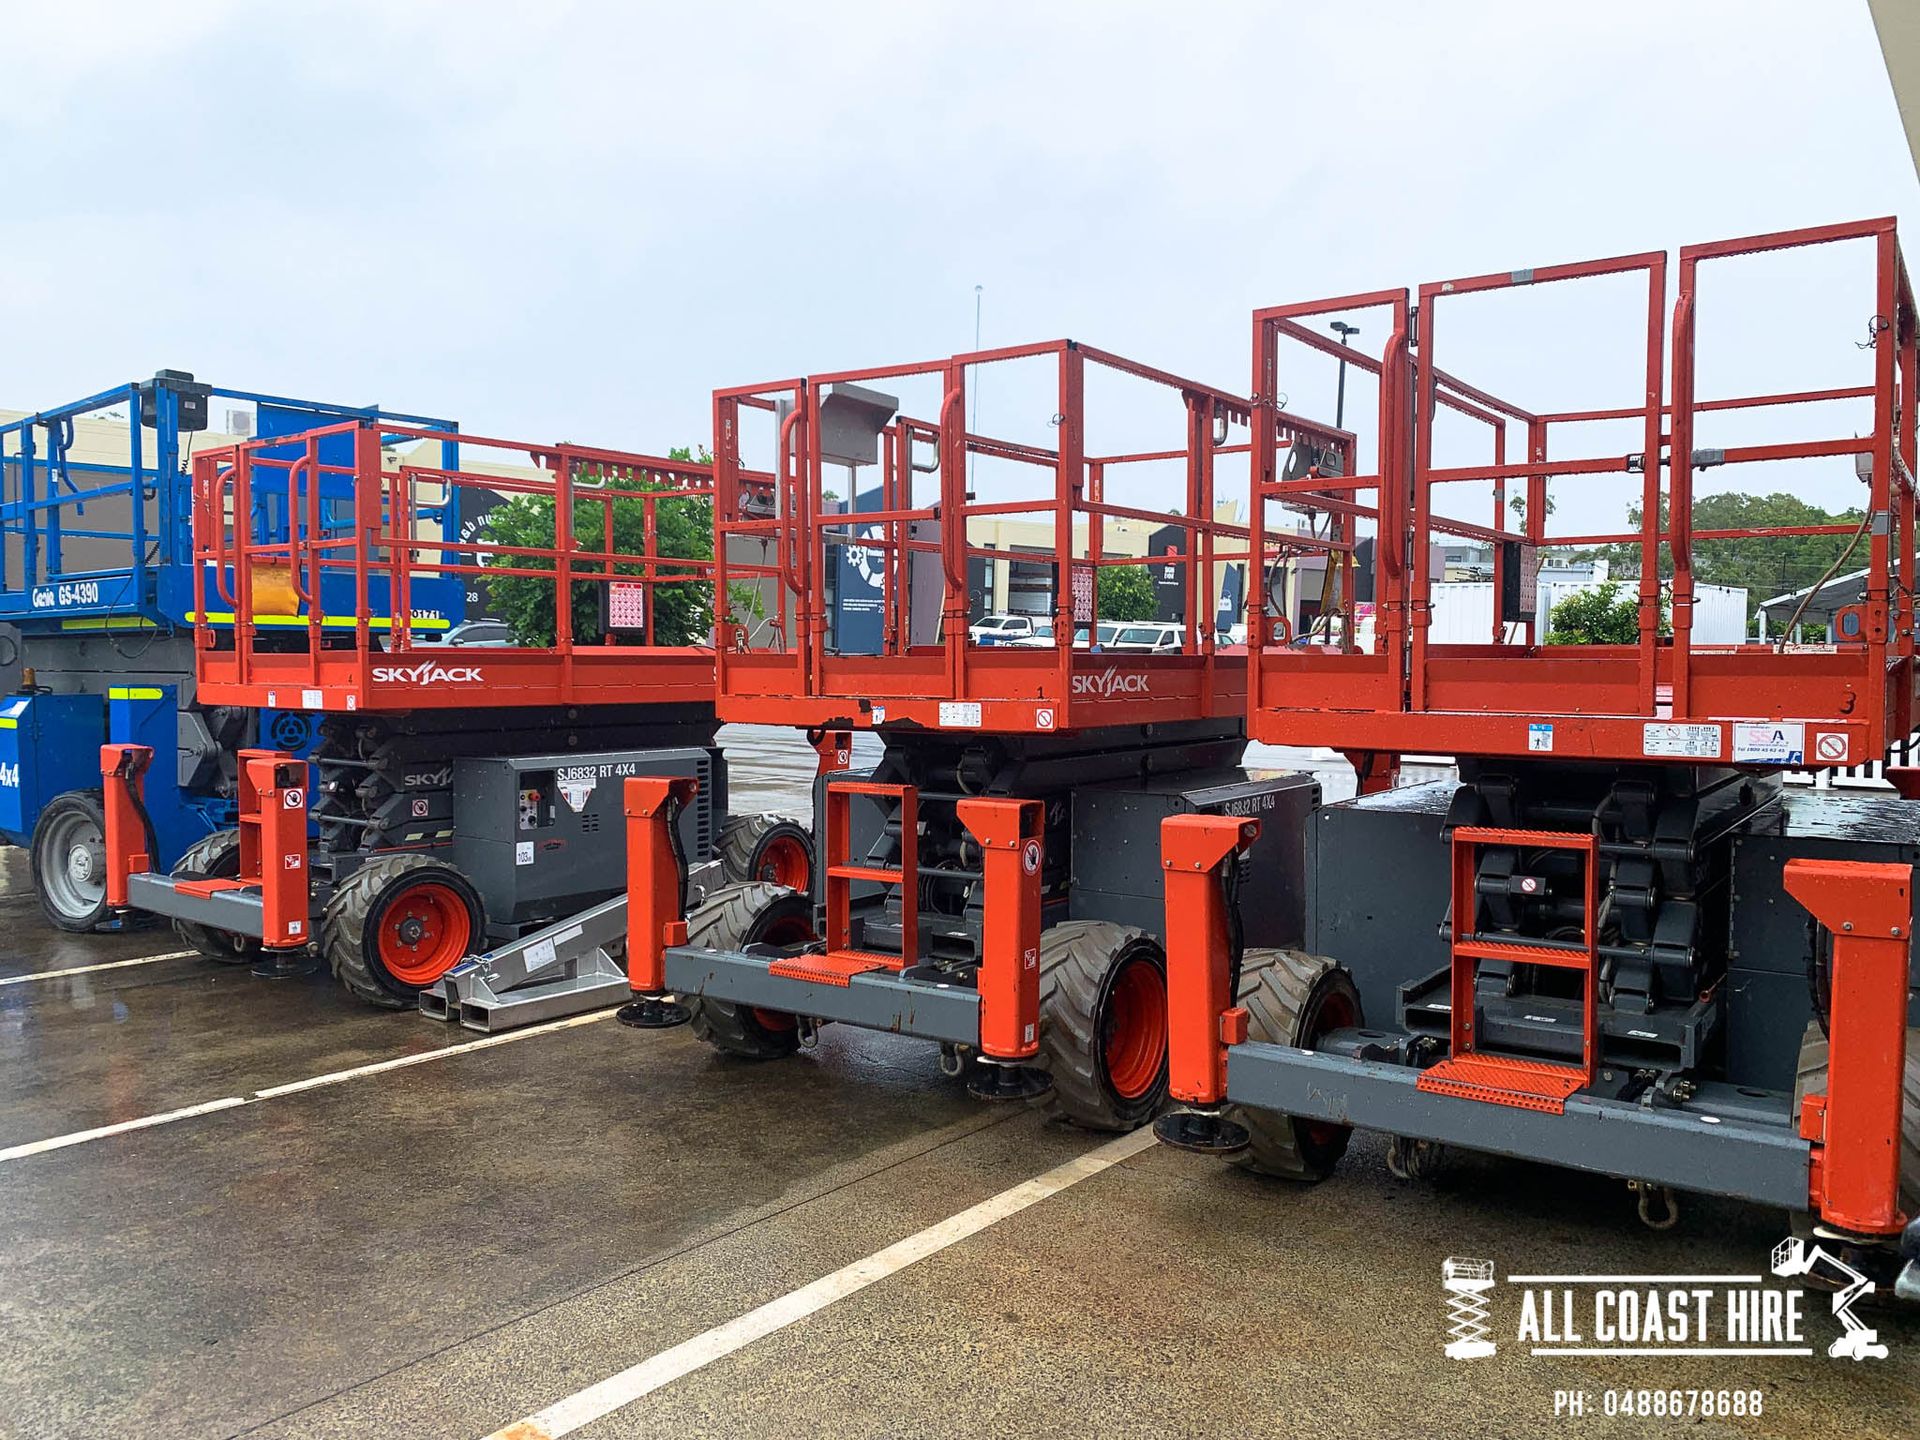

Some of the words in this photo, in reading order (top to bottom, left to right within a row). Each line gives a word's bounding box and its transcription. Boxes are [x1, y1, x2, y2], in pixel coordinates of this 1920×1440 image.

[32, 588, 55, 608] Genie
[58, 582, 99, 606] GS-4390
[466, 592, 479, 602] 28
[410, 609, 437, 619] 0171
[372, 660, 485, 686] SKYJACK
[1072, 665, 1150, 697] SKYJACK
[1840, 691, 1857, 715] 3
[0, 762, 19, 788] 4x4
[557, 766, 597, 781] SJ6832
[599, 765, 613, 778] RT
[615, 763, 636, 776] 4X4
[1252, 797, 1261, 813] RT
